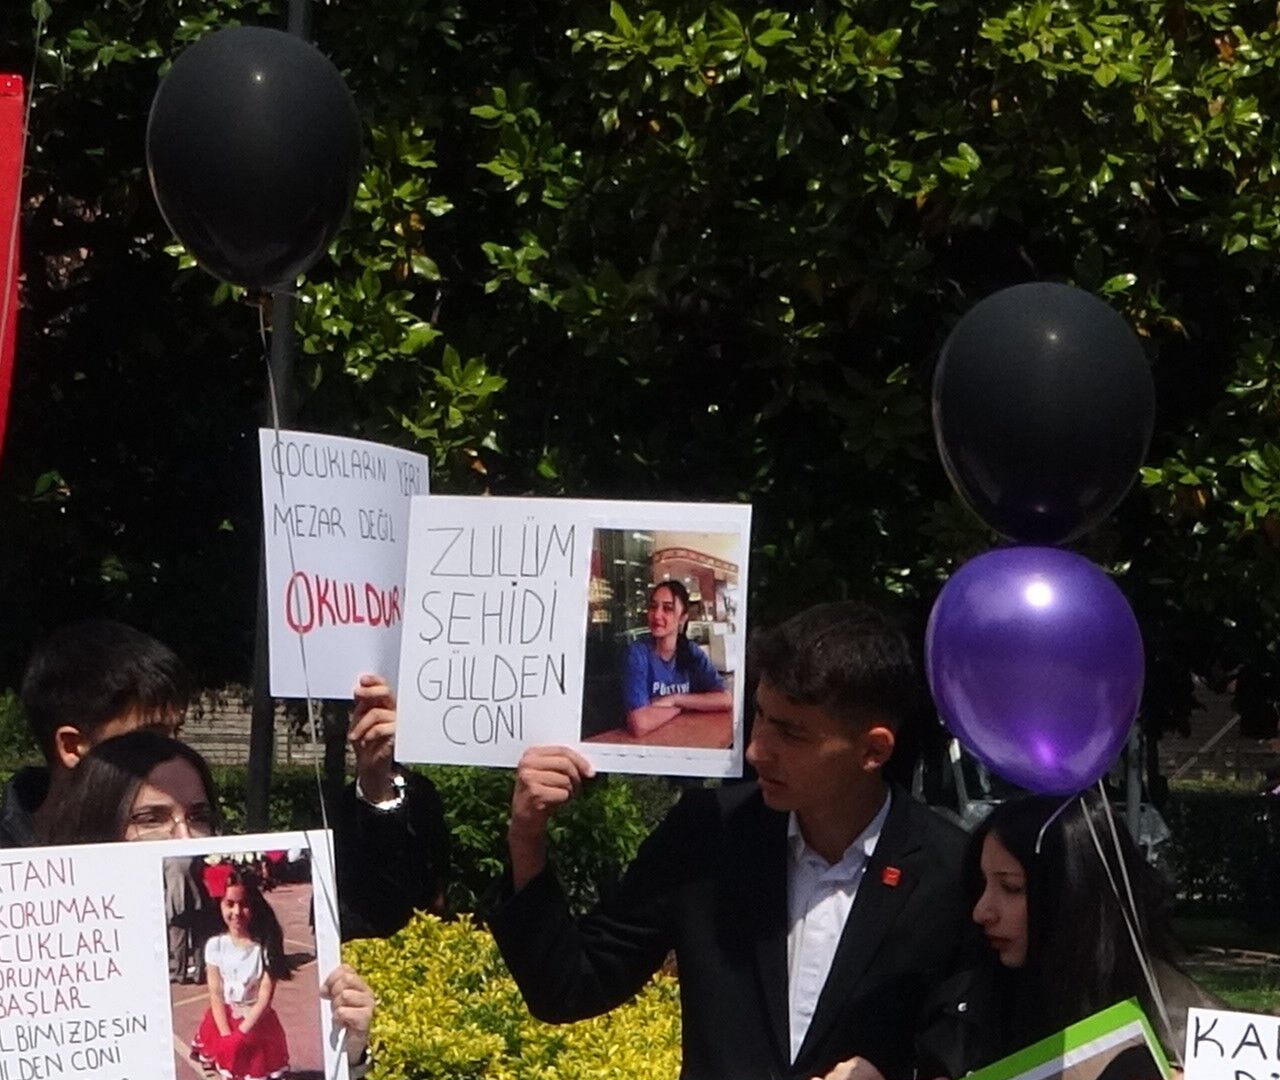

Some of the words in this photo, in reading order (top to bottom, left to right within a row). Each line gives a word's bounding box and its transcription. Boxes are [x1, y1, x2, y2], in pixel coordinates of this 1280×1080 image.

[273, 503, 347, 538] MEZAR
[427, 516, 575, 578] ZULÜM
[419, 580, 557, 645] ŞEHİDİ
[417, 650, 567, 702] GÜLDEN
[71, 1041, 121, 1071] CONİ
